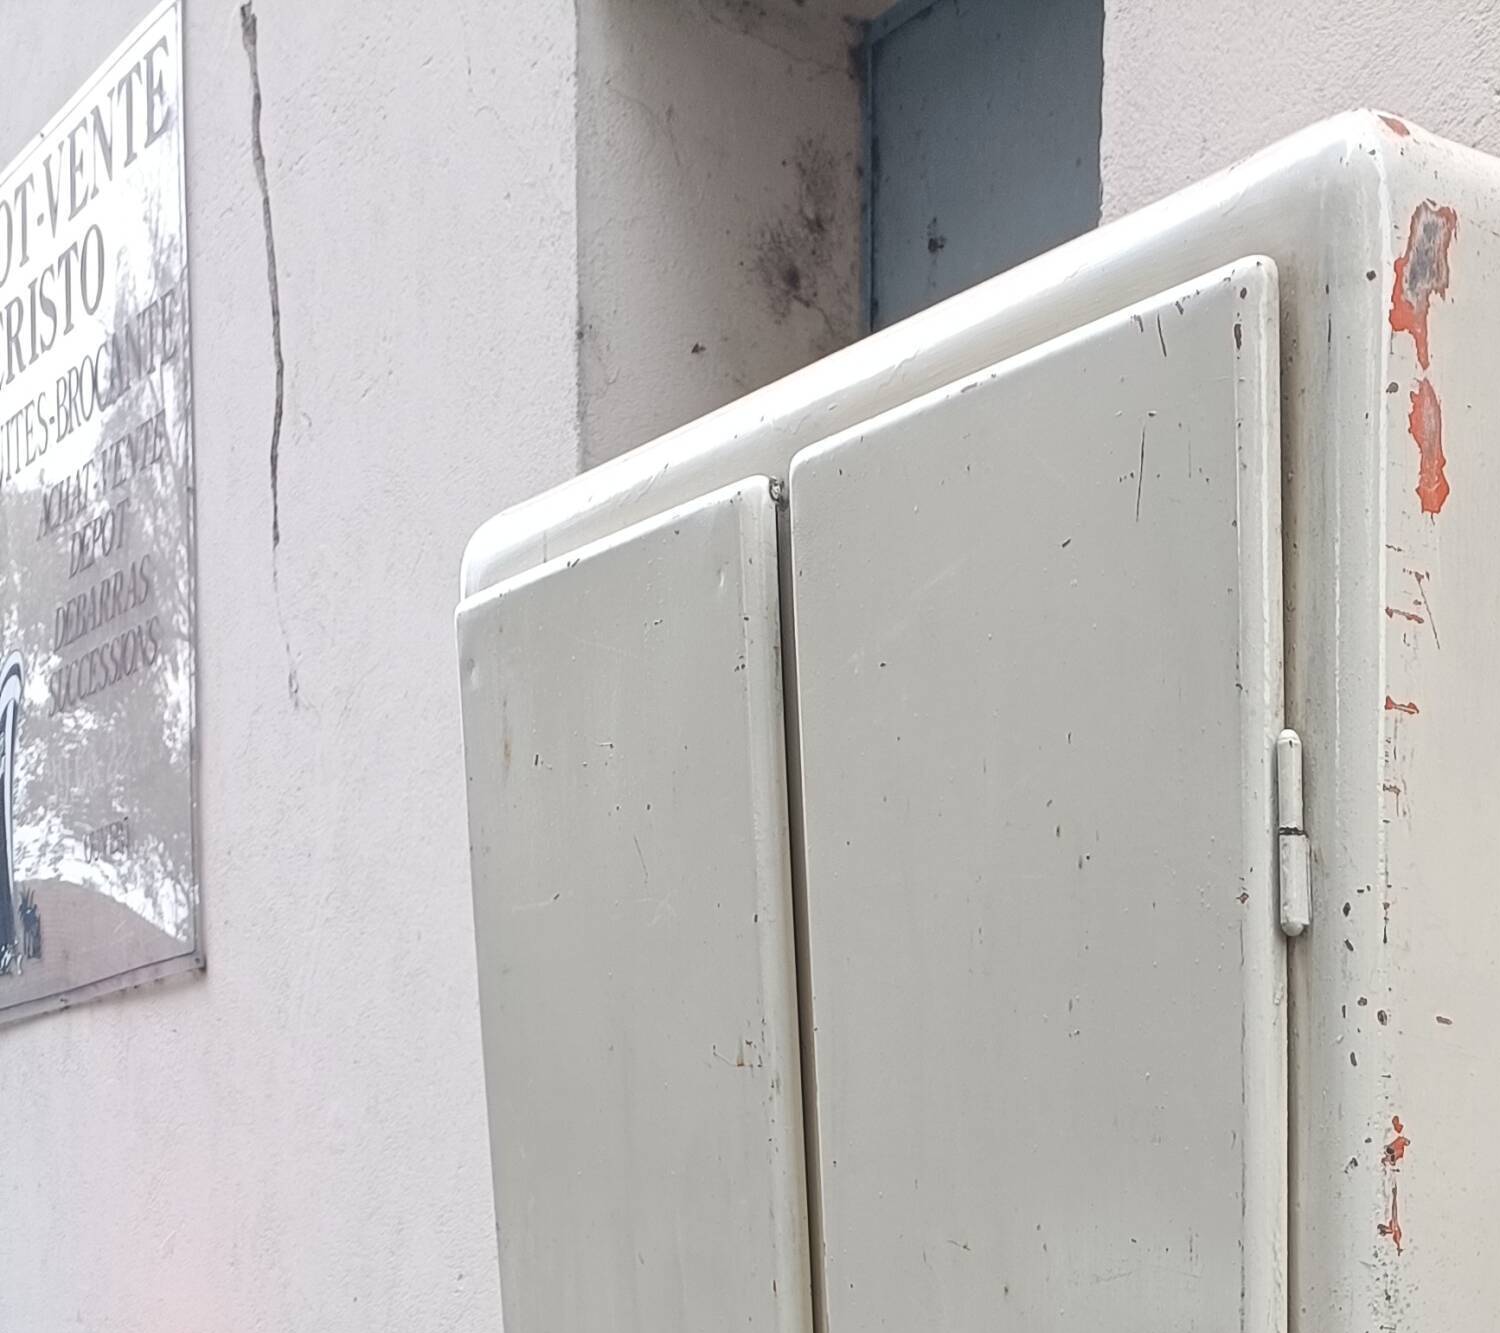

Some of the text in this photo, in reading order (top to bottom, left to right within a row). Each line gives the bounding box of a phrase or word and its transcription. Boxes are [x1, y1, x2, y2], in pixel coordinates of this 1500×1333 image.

[0, 223, 105, 391] RISTO
[0, 287, 177, 490] ITES-BROCANTE
[48, 615, 160, 718] SUCCESSIONS
[53, 553, 151, 653] DEBARRAS
